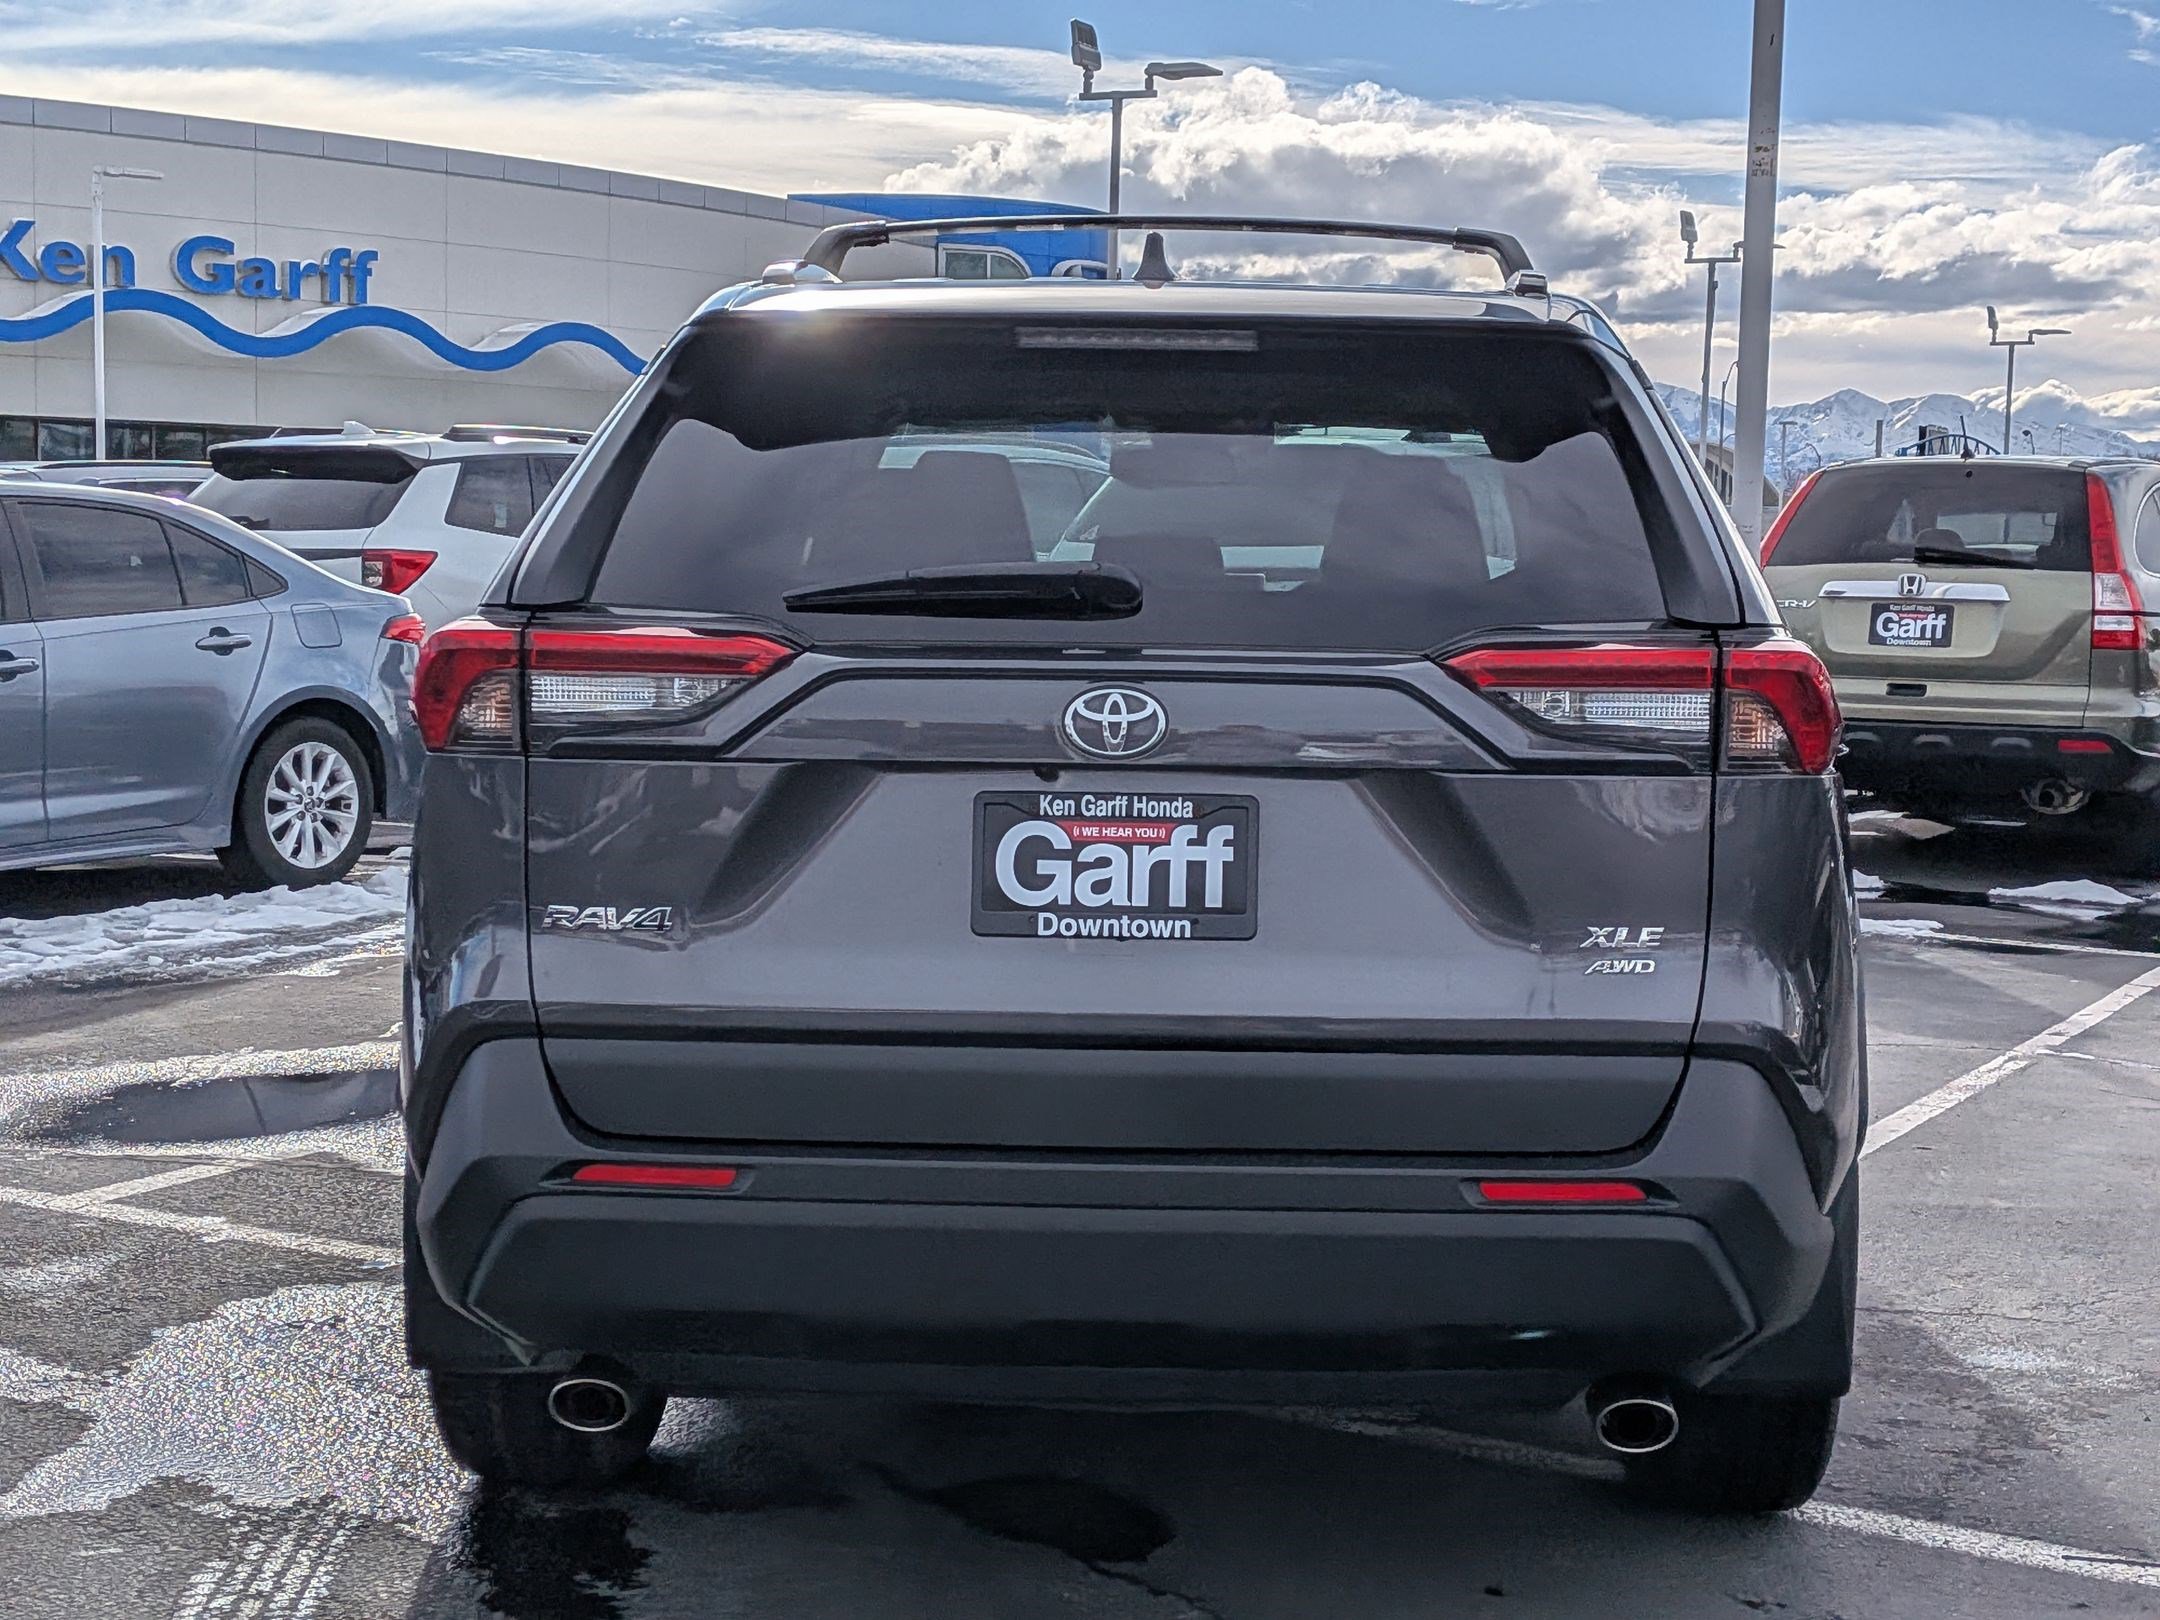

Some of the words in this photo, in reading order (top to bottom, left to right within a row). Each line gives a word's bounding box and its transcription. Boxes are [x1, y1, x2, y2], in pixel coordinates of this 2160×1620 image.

[172, 235, 379, 304] Garff
[1876, 611, 1947, 639] Garff
[1886, 637, 1932, 647] Downtown
[1039, 794, 1076, 817] Ken
[1081, 795, 1129, 818] Garff
[1132, 796, 1194, 819] Honda
[1081, 826, 1100, 837] WE
[1102, 827, 1133, 838] HEAR
[1134, 827, 1158, 838] YOU
[995, 819, 1235, 908] Garff
[541, 904, 673, 934] RAV4
[1037, 911, 1192, 939] Downtown
[1580, 926, 1665, 948] XLE
[1584, 959, 1656, 975] AWD
